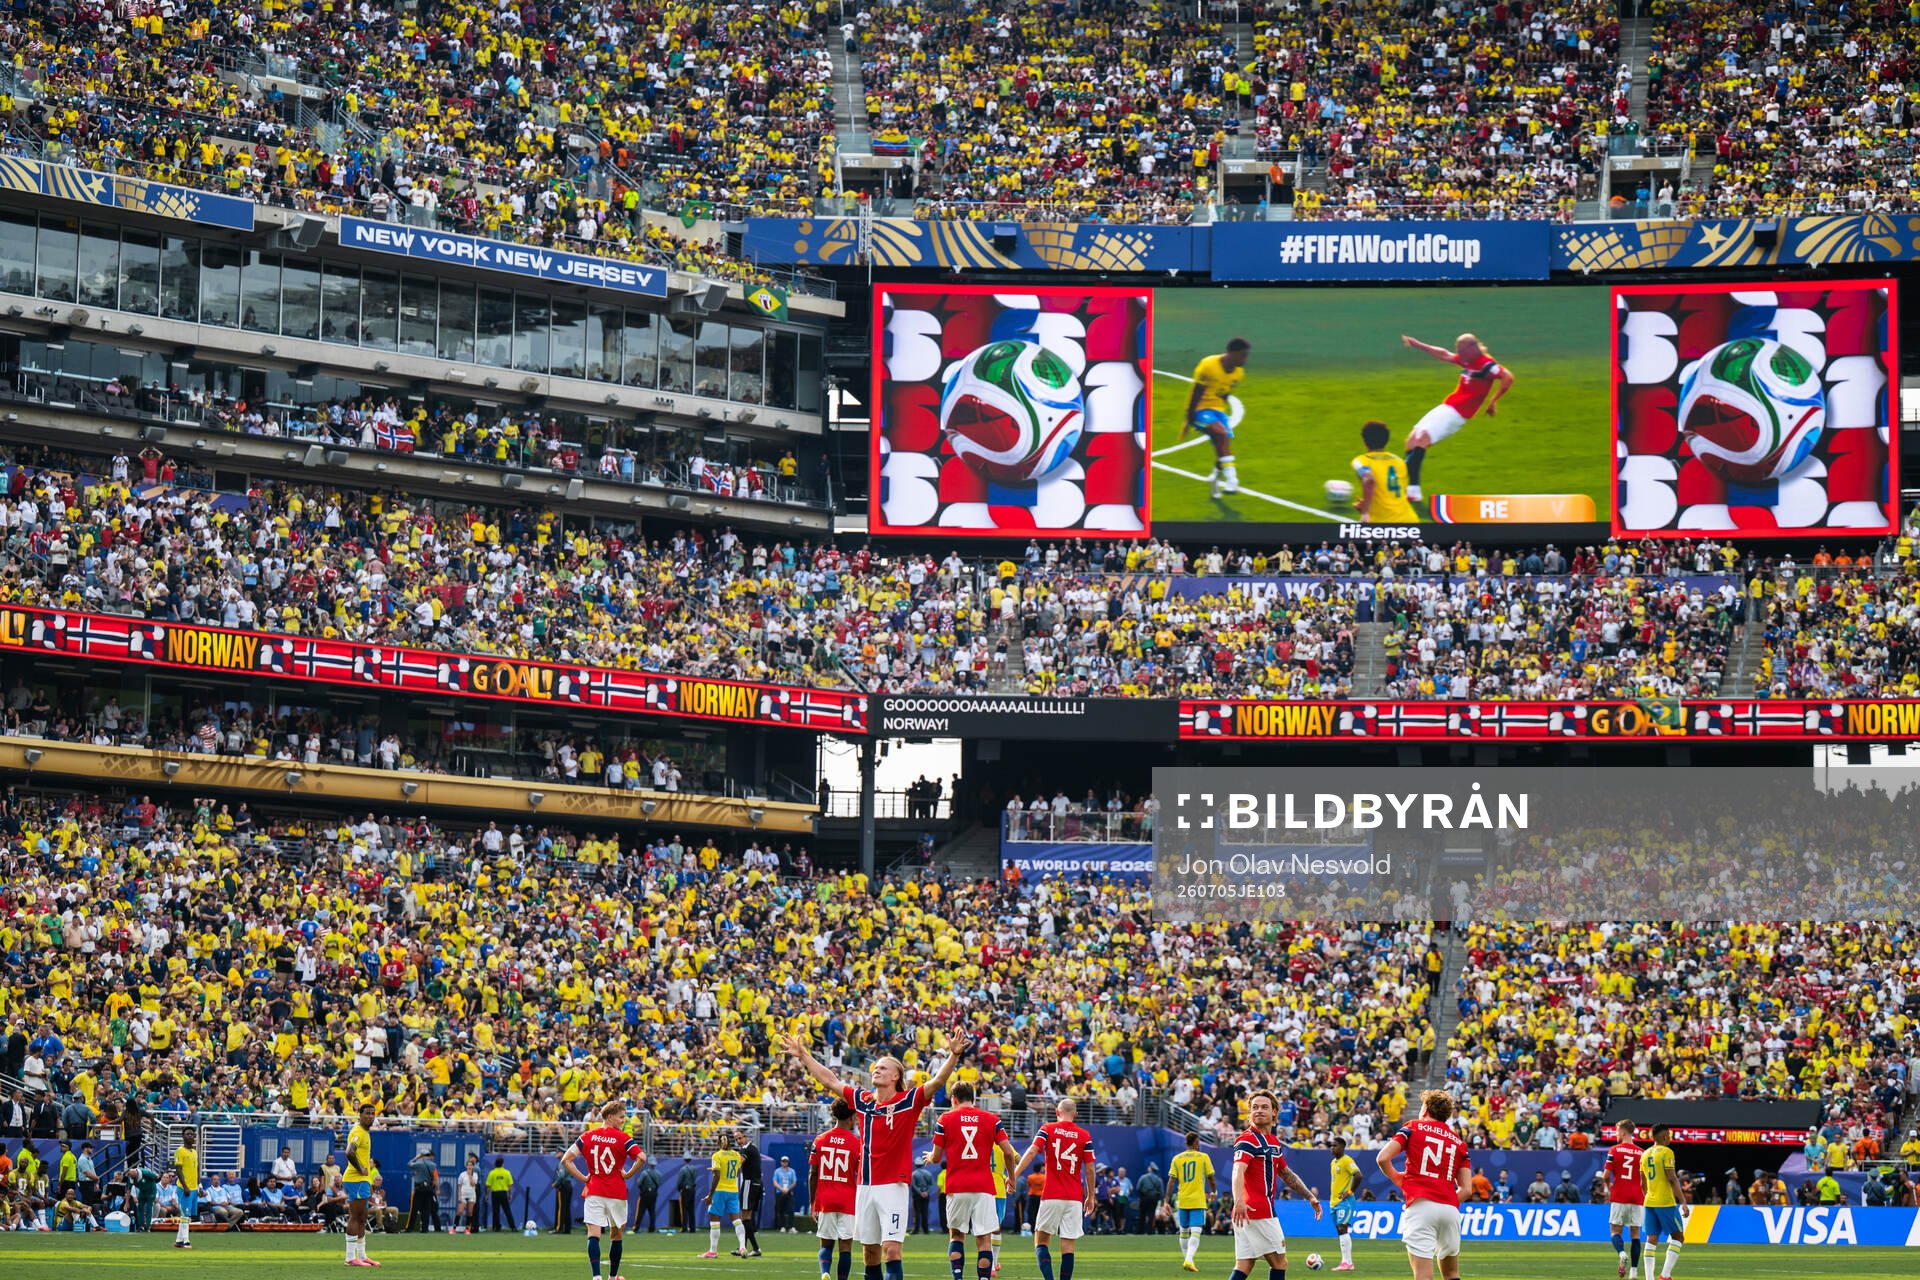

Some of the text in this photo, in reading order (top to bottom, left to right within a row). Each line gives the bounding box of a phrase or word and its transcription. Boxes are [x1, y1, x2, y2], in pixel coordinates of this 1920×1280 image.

[355, 225, 653, 287] NEW YORK NEW JERSEY
[1280, 233, 1480, 269] #FIFAWorldCup
[1387, 465, 1401, 498] 4
[1479, 500, 1509, 519] RE
[1339, 524, 1421, 539] Hisense
[0, 609, 26, 646] L!
[168, 628, 258, 669] NORWAY
[473, 661, 553, 700] GOAL!
[680, 681, 759, 718] NORWAY
[883, 699, 1085, 715] GOOOOOOOAAAAAALLLLLLL!
[883, 717, 949, 731] NORWAY!
[1236, 705, 1337, 736] NORWAY
[1848, 703, 1920, 735] NORW
[1002, 859, 1031, 870] FFA
[1032, 860, 1080, 871] WORLD
[961, 1126, 978, 1159] 8
[1725, 1131, 1761, 1143] NORWAY
[590, 1144, 616, 1175] 10
[726, 1159, 738, 1179] 18
[819, 1146, 850, 1183] 22
[1052, 1138, 1078, 1175] 14
[1182, 1160, 1197, 1183] 10
[1420, 1135, 1457, 1181] 21
[1621, 1155, 1635, 1180] 3
[1647, 1156, 1656, 1180] 5
[892, 1213, 900, 1229] 9
[1348, 1210, 1395, 1239] ap
[1507, 1208, 1581, 1237] VISA
[1752, 1206, 1858, 1244] VISA
